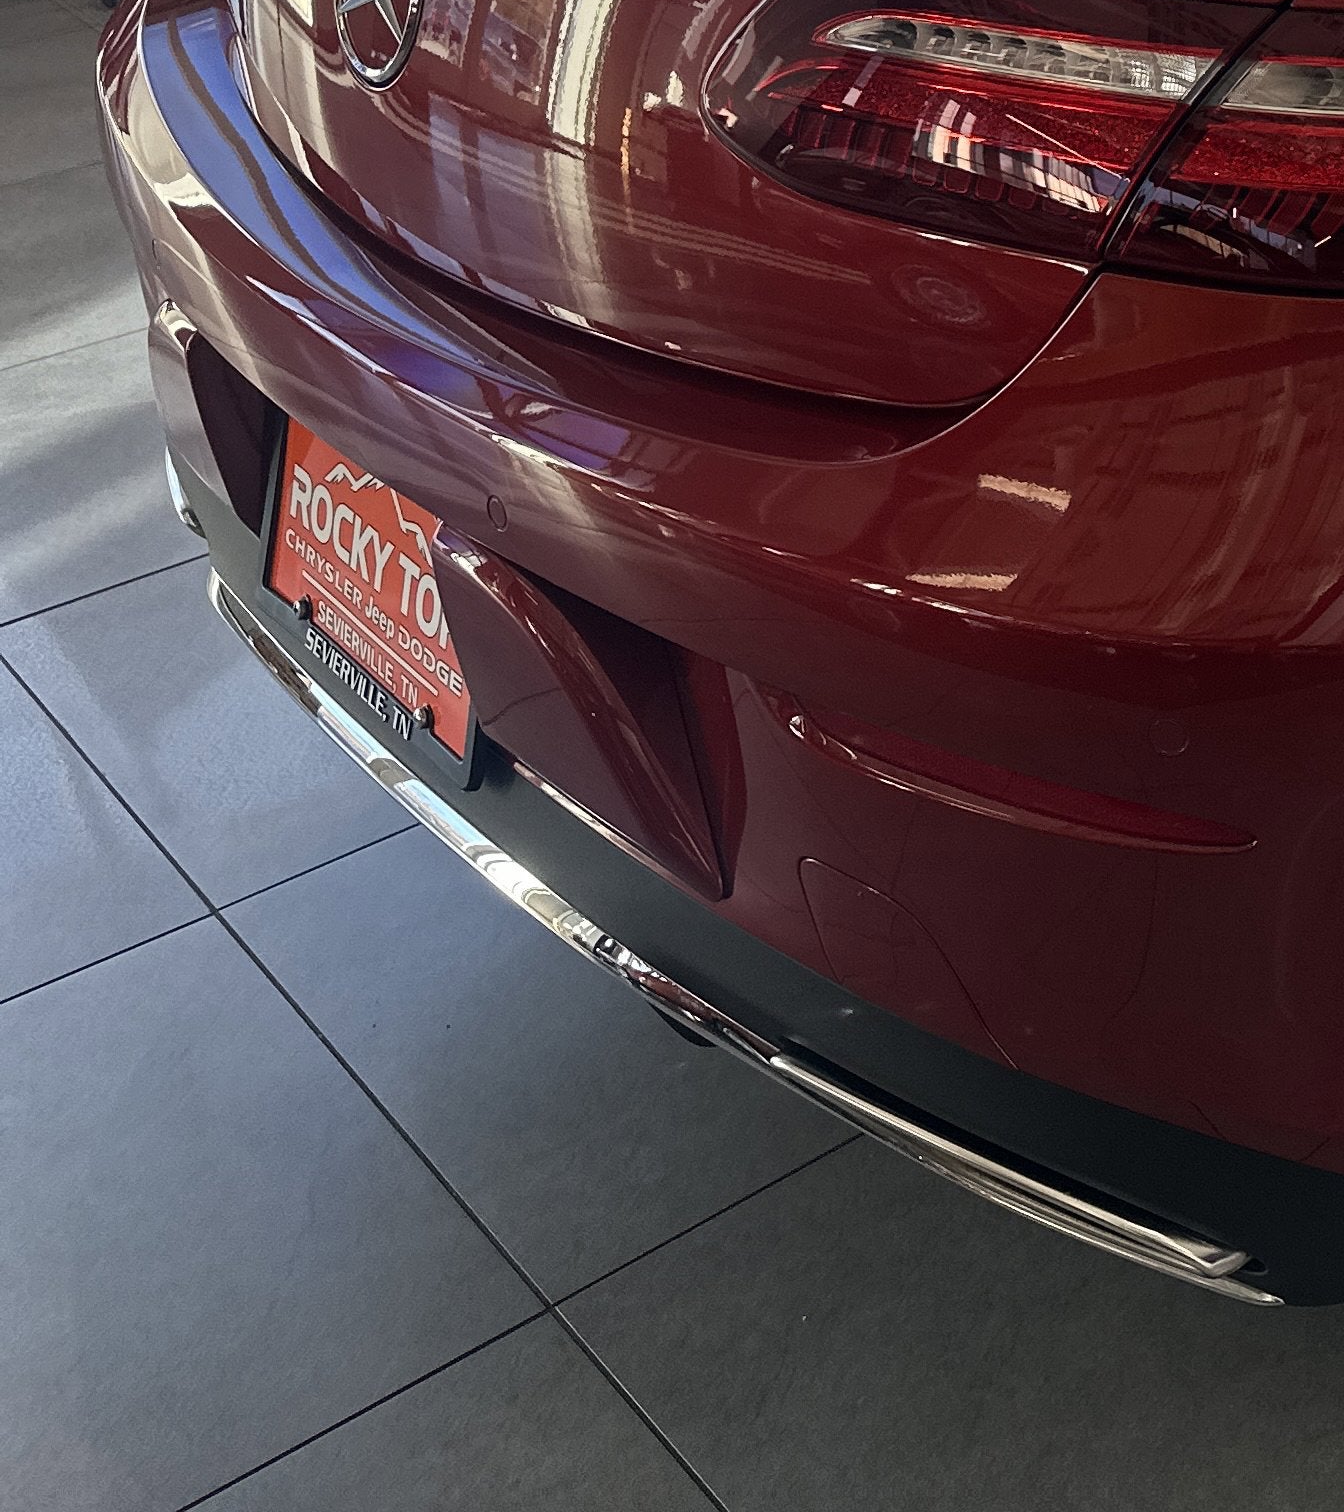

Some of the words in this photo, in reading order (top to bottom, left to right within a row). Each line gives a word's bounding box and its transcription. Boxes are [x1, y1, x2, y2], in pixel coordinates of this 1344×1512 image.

[289, 463, 395, 593] ROCKY
[285, 528, 363, 610] CHRYSLER
[365, 596, 395, 640] Jeep
[398, 625, 464, 698] DODGE
[317, 600, 397, 694] SEVIERVILLE,
[400, 674, 418, 709] TN
[304, 627, 387, 722] SEVIERVILLE,
[392, 705, 412, 741] TN
